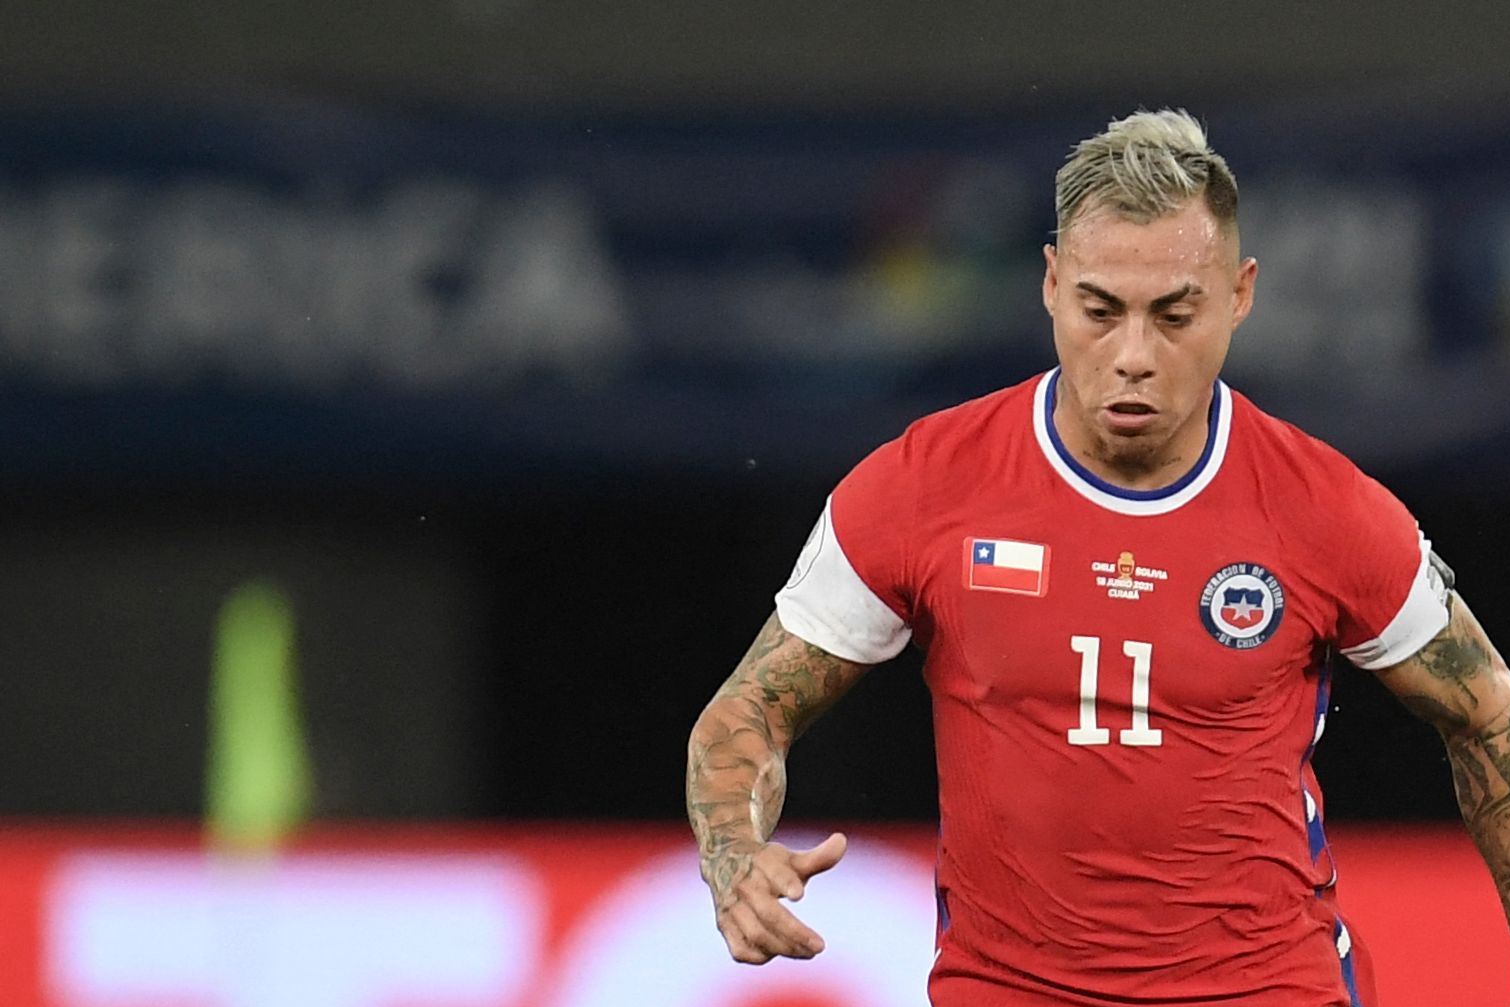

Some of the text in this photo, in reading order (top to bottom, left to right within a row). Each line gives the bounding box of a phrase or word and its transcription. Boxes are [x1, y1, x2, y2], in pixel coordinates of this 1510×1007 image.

[1092, 561, 1116, 573] CHILE
[1135, 566, 1168, 580] BOLIVIA
[1251, 565, 1265, 577] DE
[1218, 633, 1262, 649] DE CHILE
[1067, 635, 1162, 746] 11
